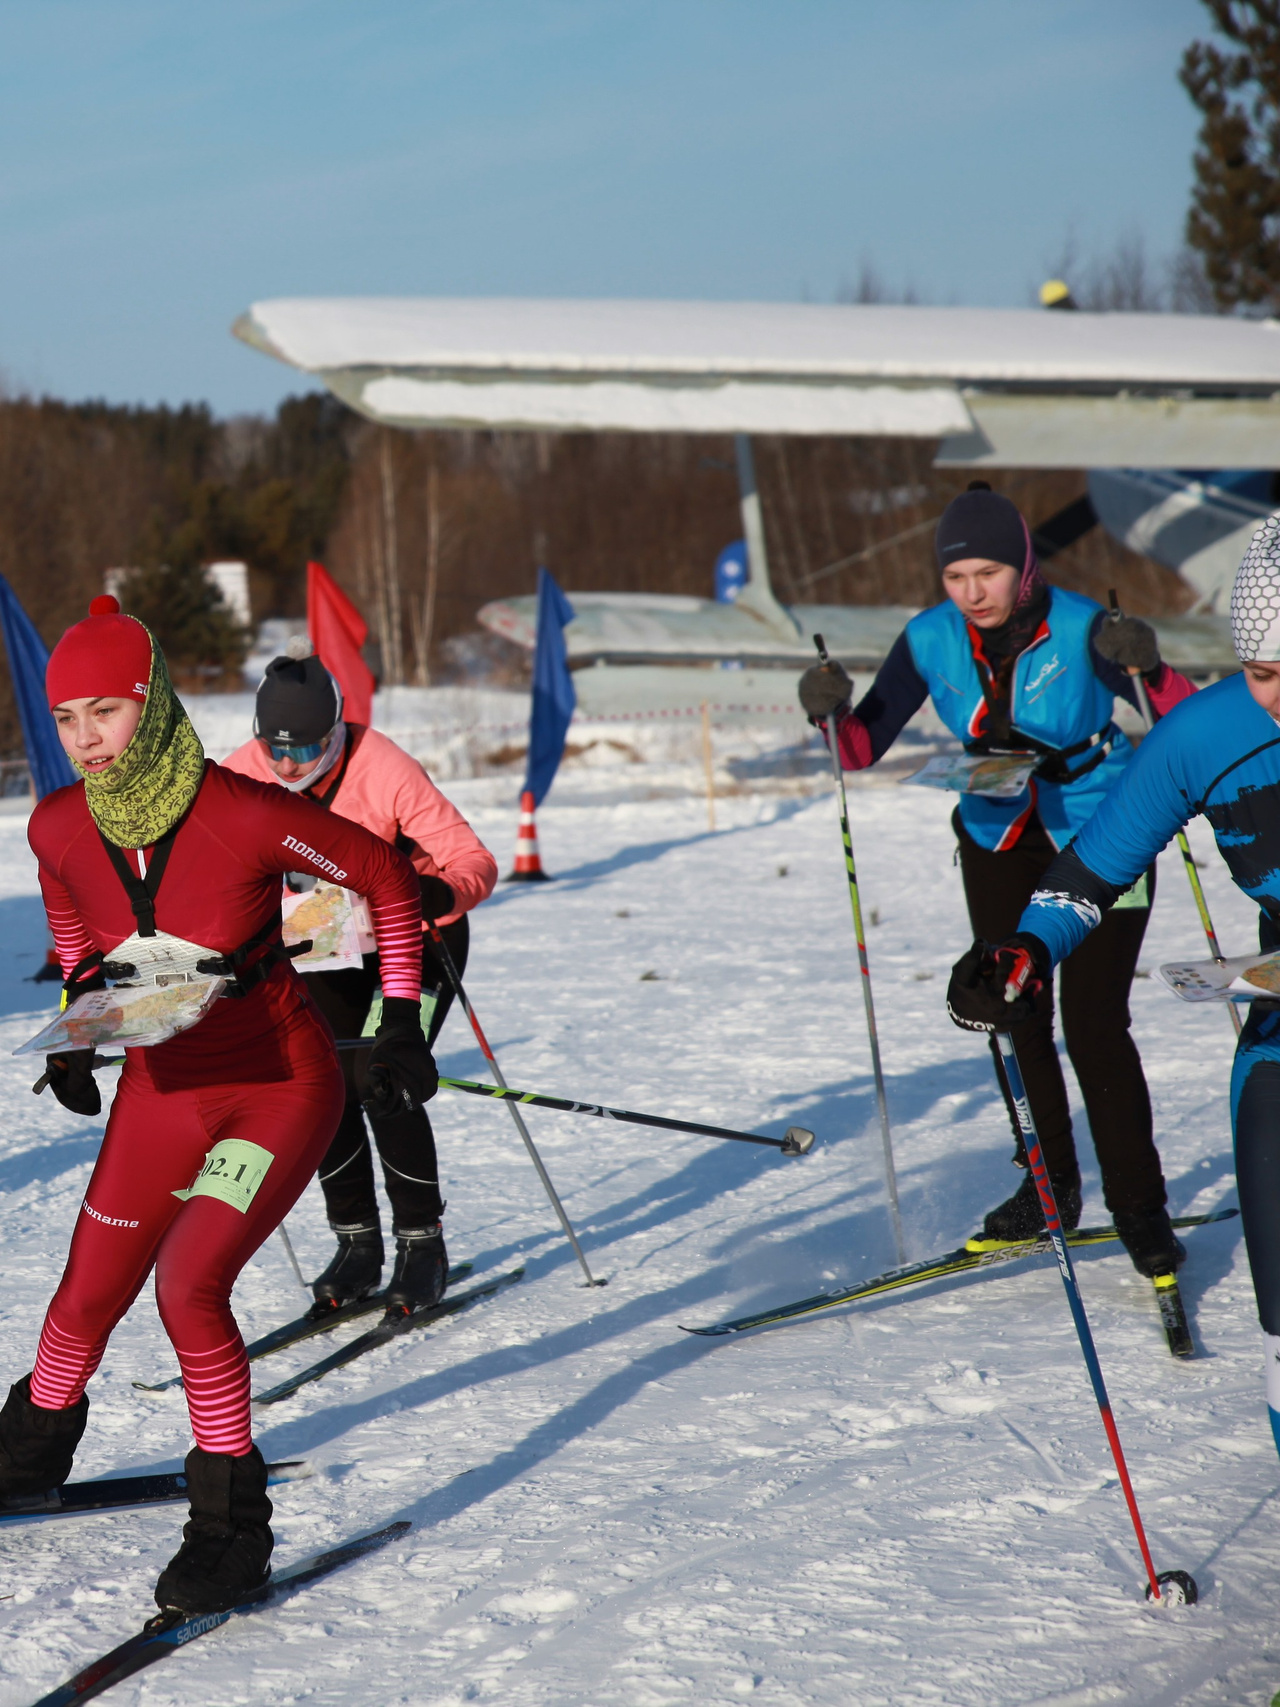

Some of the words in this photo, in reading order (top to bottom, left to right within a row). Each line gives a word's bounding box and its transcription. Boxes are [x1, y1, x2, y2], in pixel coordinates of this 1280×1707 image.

[281, 834, 348, 881] noname
[83, 1198, 140, 1228] noname
[978, 1240, 1054, 1267] FISCHER
[1051, 1235, 1072, 1282] winner
[176, 1612, 222, 1645] salomon
